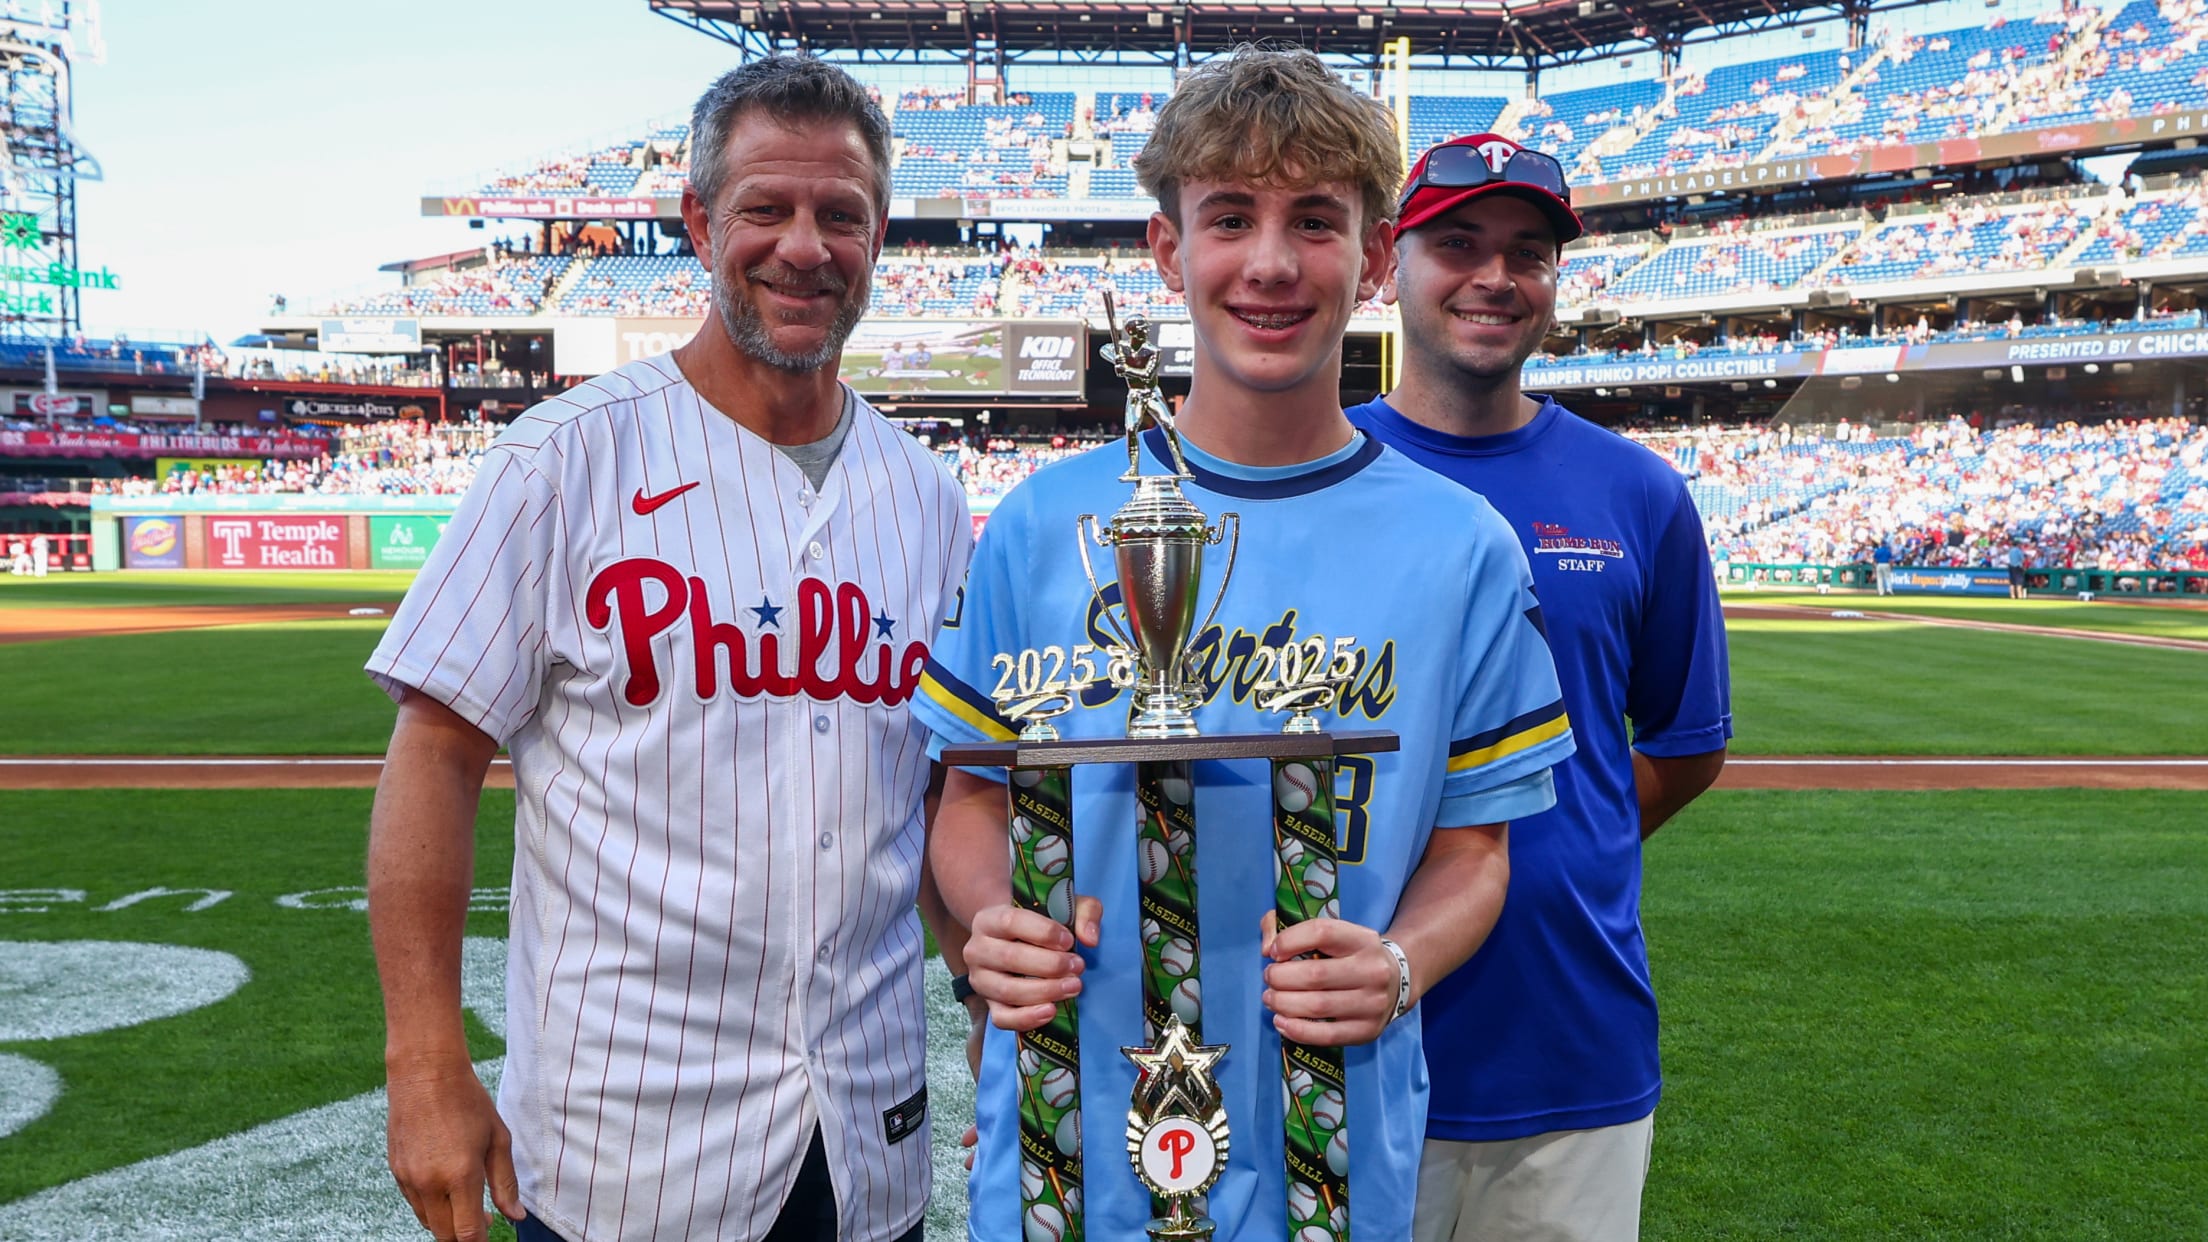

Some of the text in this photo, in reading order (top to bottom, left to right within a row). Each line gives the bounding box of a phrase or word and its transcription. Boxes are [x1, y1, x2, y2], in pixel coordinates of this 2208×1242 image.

[1478, 141, 1517, 173] P
[1623, 163, 1818, 197] PHILADELPHI
[49, 263, 120, 290] Bank
[1030, 359, 1064, 371] OFFICE
[2007, 341, 2103, 361] PRESENTED
[2107, 338, 2132, 356] BY
[1017, 369, 1076, 382] TECHNOLOGY
[1528, 368, 1582, 387] HARPER
[1585, 365, 1633, 384] FUNKO
[1636, 362, 1672, 381] POP!
[1675, 358, 1777, 379] COLLECTIBLE
[258, 521, 339, 552] Temple
[1540, 537, 1620, 552] HOME RUN
[260, 546, 336, 566] Health
[1558, 558, 1605, 572] STAFF
[585, 556, 930, 708] Phillie
[990, 644, 1097, 698] 2025
[1255, 637, 1357, 690] 2025
[1018, 792, 1070, 833] BASEBAL
[1285, 814, 1338, 854] BASEBAL
[1142, 895, 1198, 938] BASEBALL
[1293, 1046, 1347, 1083] BASEBAL
[1158, 1129, 1195, 1179] P
